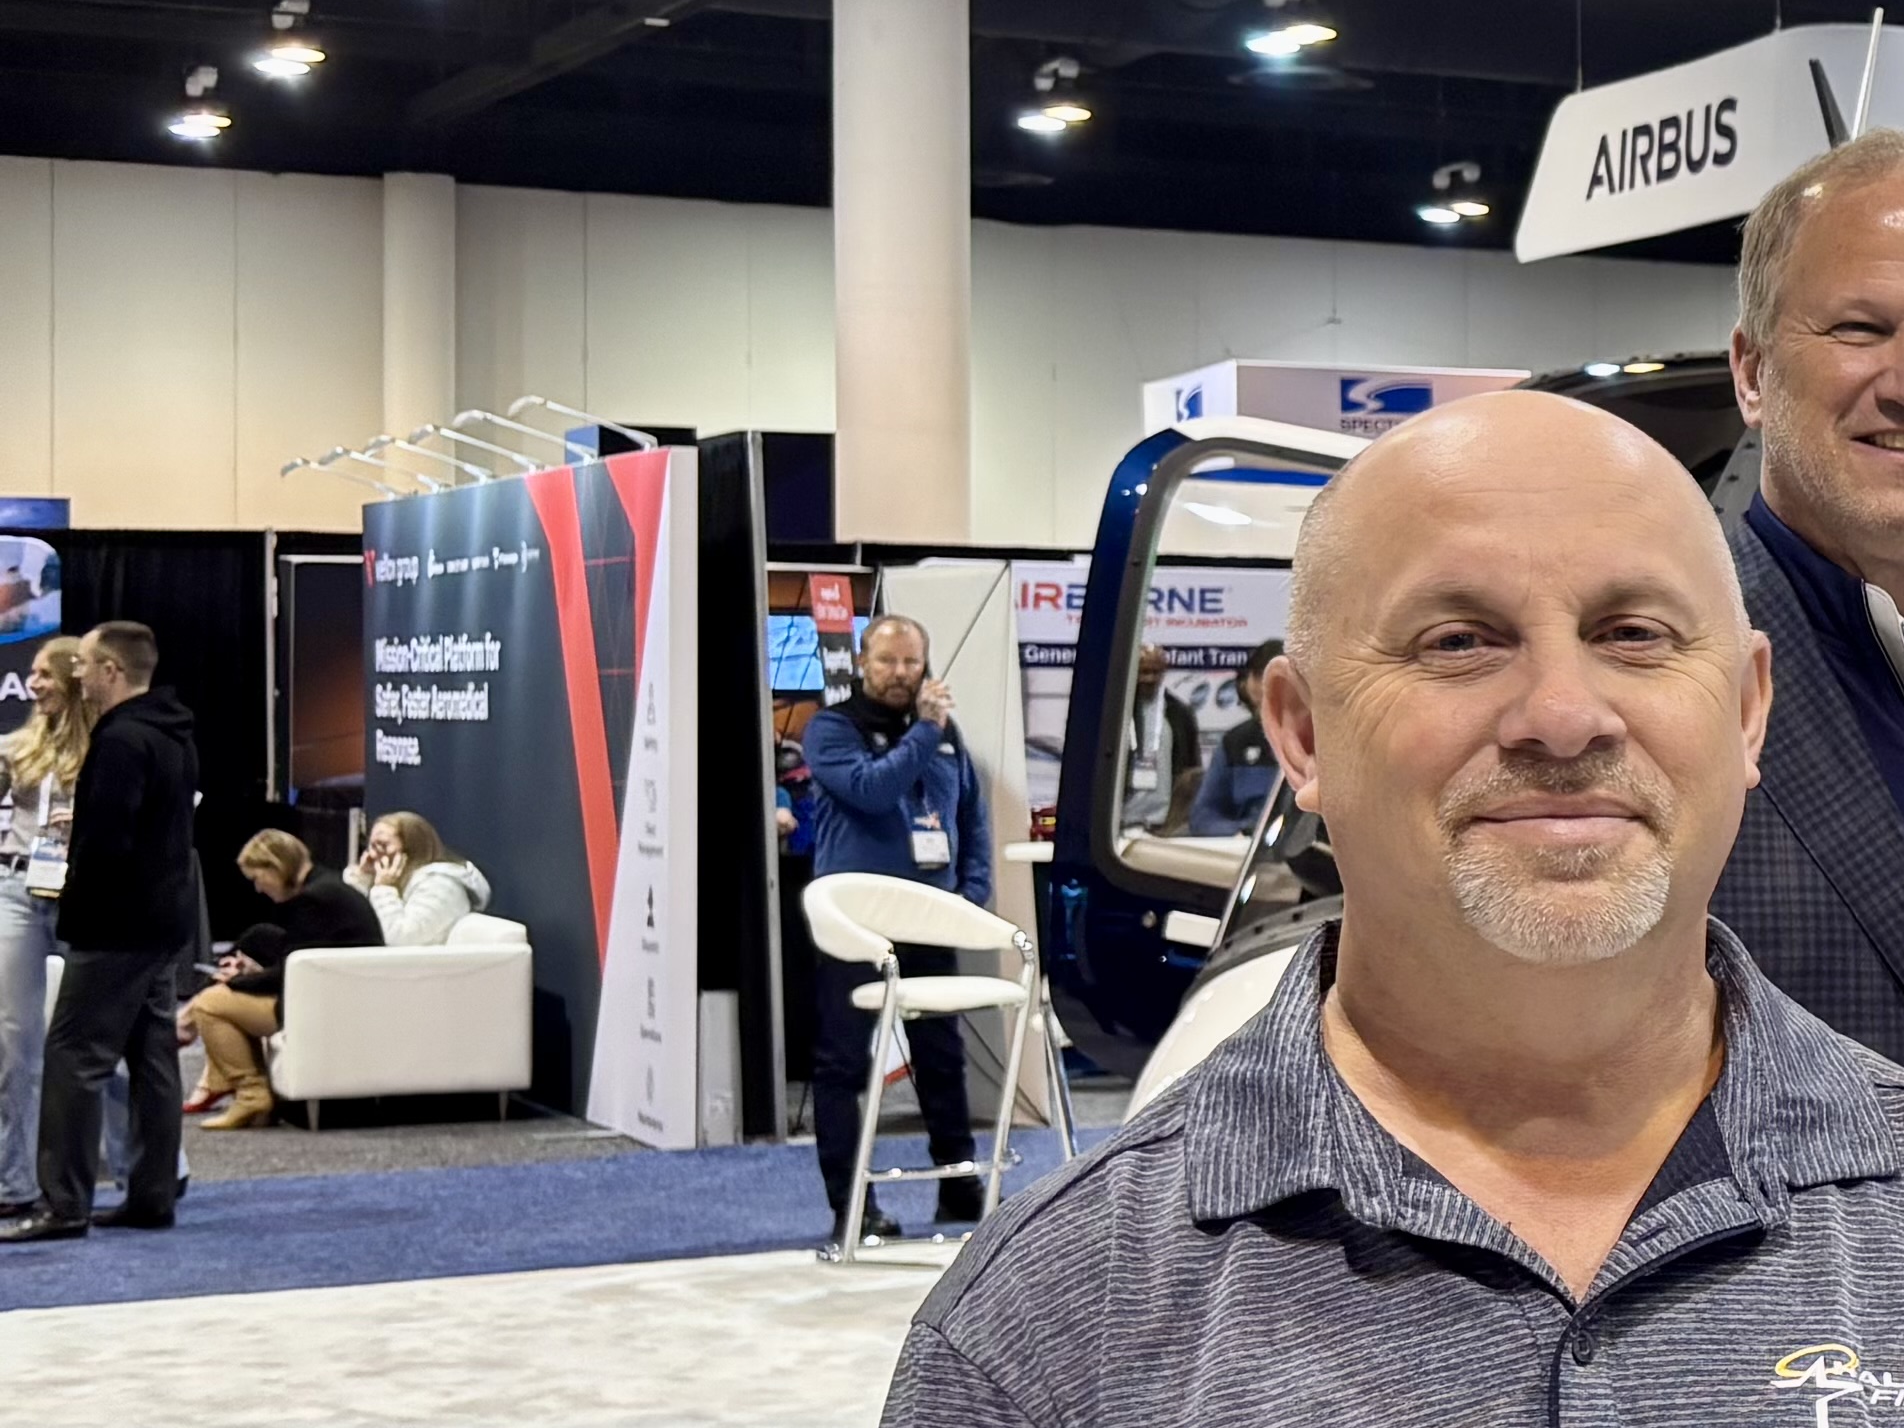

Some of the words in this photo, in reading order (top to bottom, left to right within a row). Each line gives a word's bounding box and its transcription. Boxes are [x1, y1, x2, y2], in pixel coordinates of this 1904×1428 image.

[1586, 96, 1738, 201] AIRBUS
[485, 631, 501, 671] for
[1209, 648, 1249, 665] Tran
